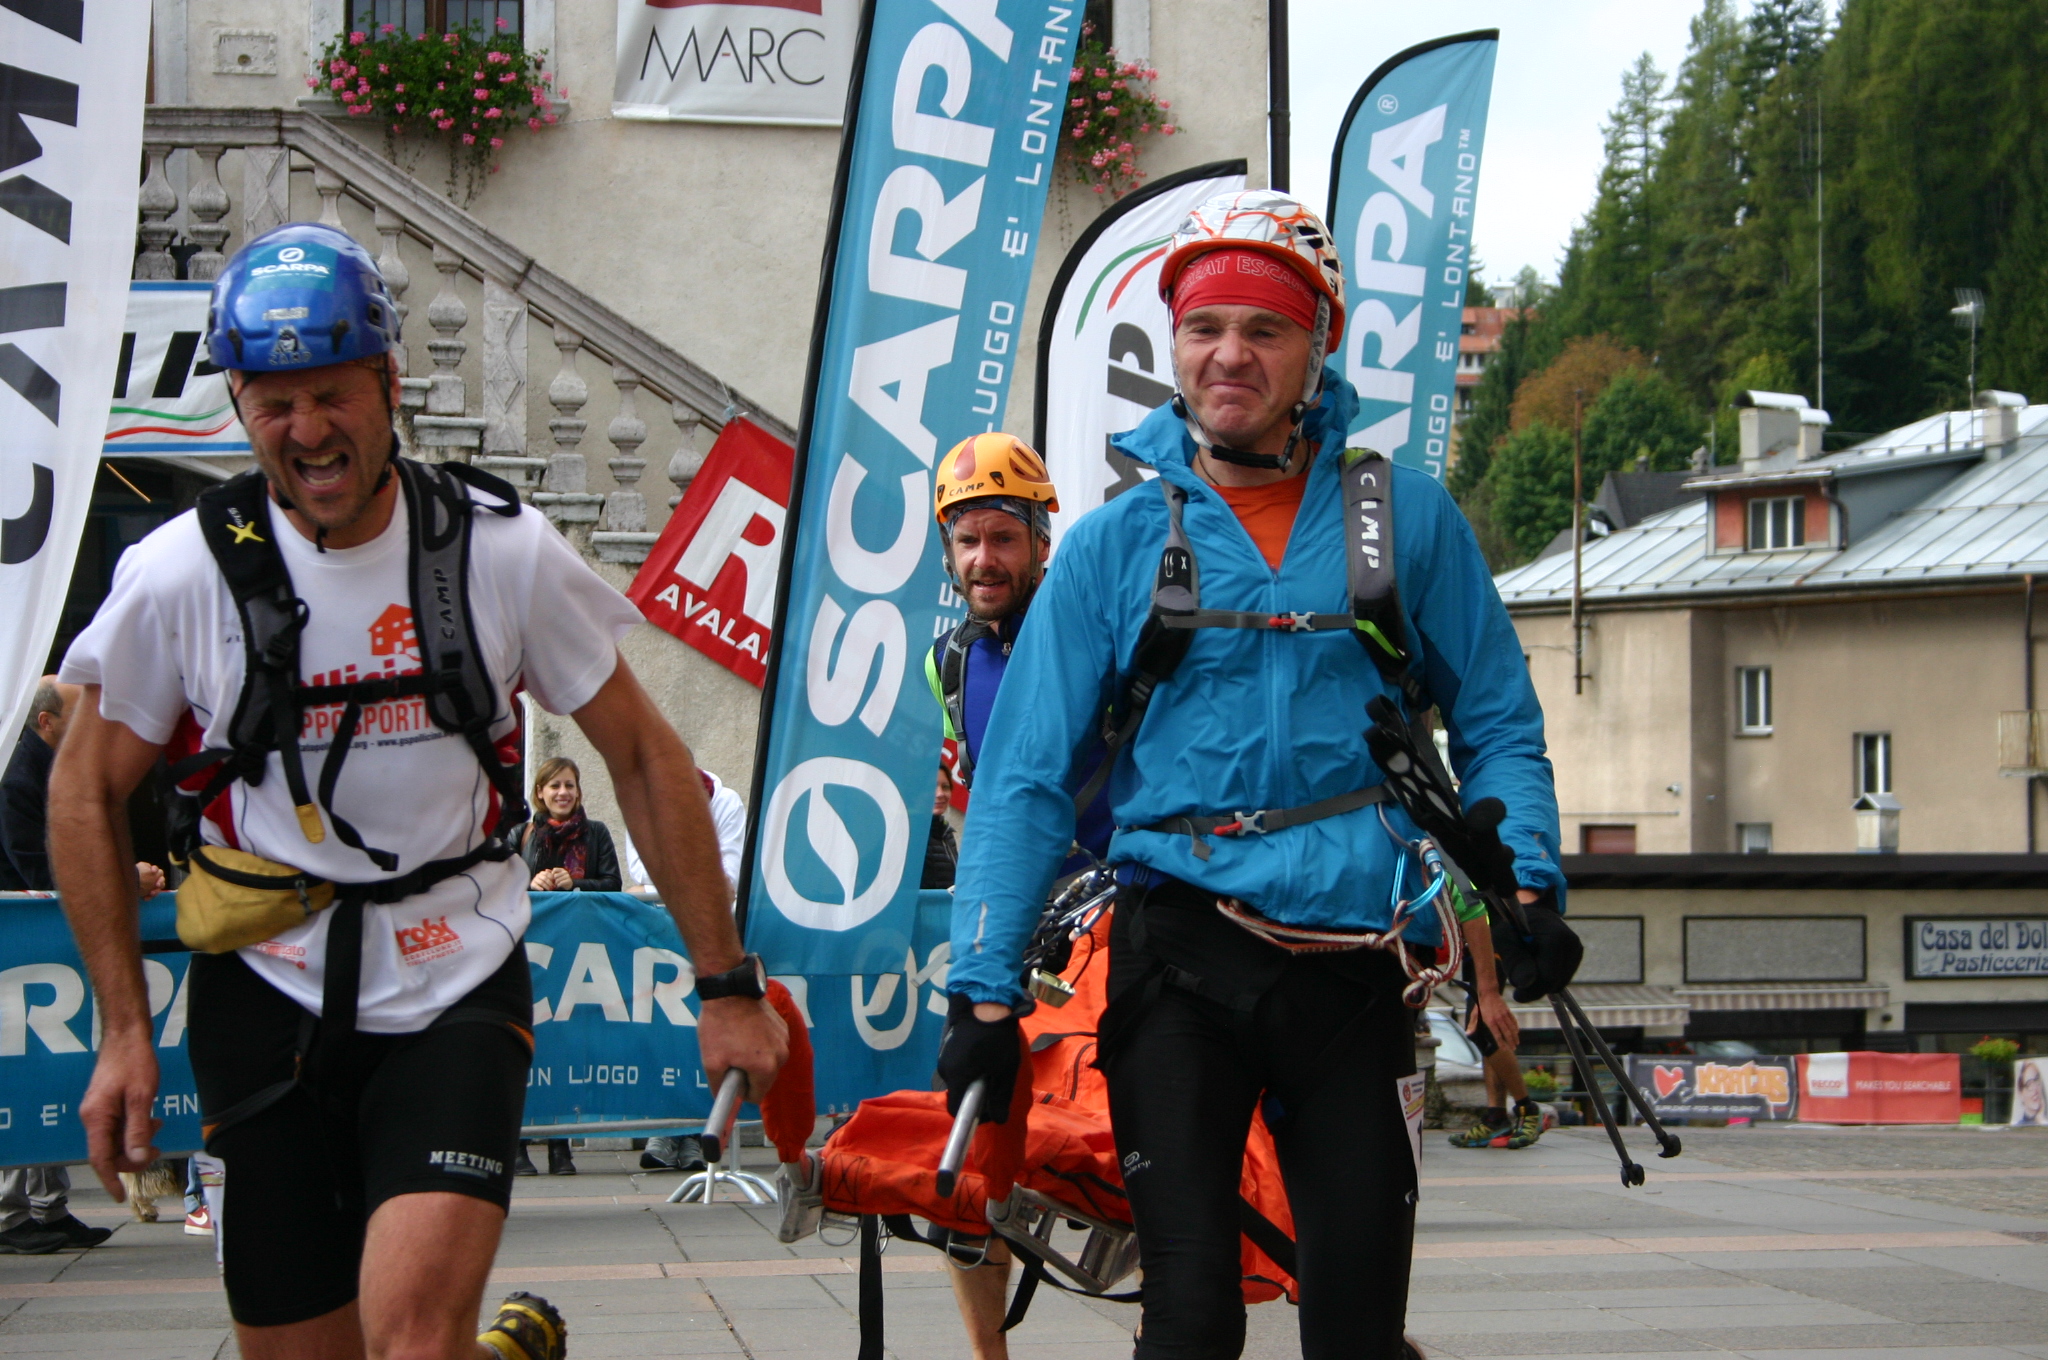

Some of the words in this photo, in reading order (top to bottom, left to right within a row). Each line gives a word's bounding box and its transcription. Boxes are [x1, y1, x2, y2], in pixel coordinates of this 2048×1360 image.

[640, 24, 825, 86] MARC
[1015, 0, 1073, 185] LONTAN
[251, 263, 330, 276] SCARPA
[1423, 394, 1448, 479] UOGO
[949, 481, 986, 497] CAMP
[432, 566, 457, 641] CAMP
[395, 915, 461, 948] robi
[1921, 922, 1973, 950] Casa
[1980, 922, 2009, 950] del
[568, 1064, 639, 1086] LUOGO
[1695, 1060, 1789, 1105] KRATOS
[1855, 1079, 1883, 1091] MAKES
[1884, 1080, 1900, 1091] YOU
[1903, 1080, 1951, 1092] SEARCHABLE
[429, 1150, 504, 1175] MEETING
